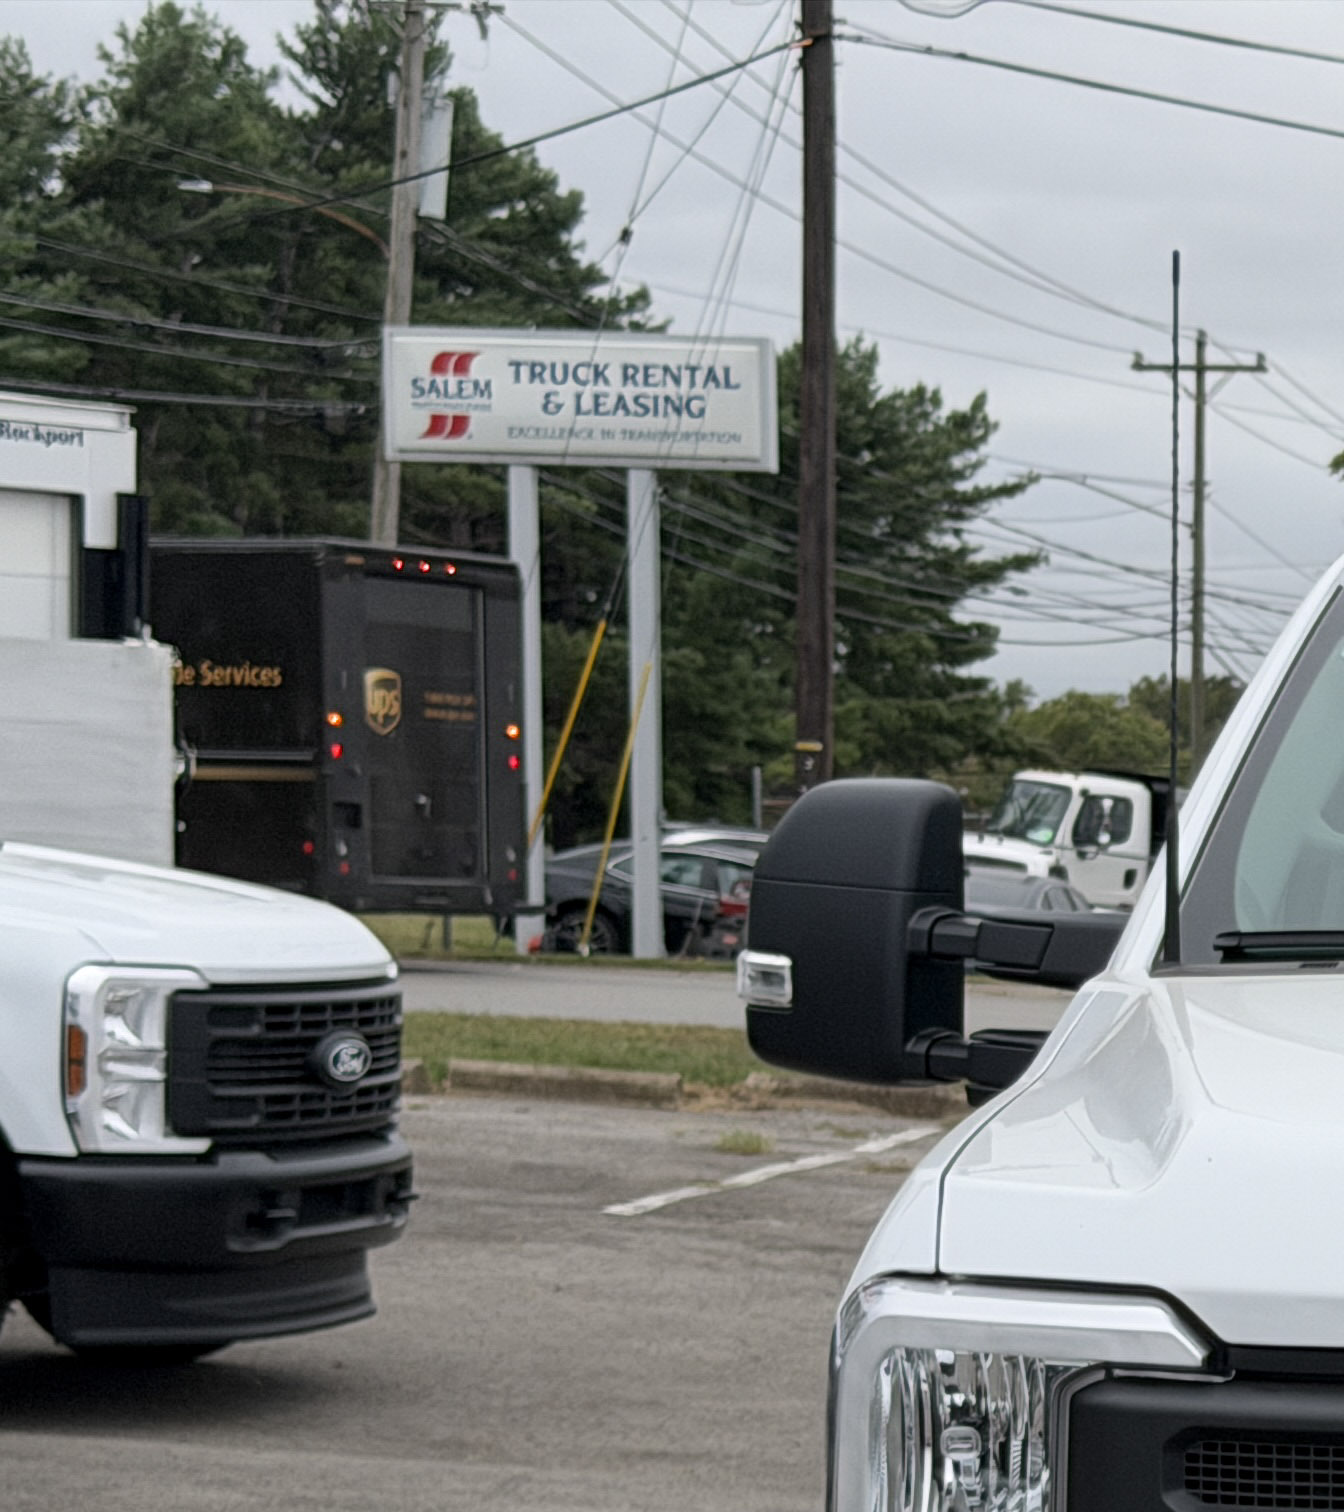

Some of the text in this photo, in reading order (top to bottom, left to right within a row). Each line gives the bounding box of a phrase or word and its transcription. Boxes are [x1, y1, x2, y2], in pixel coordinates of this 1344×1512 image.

[411, 377, 492, 400] SALEM
[508, 361, 741, 390] TRUCK RENTAL
[542, 392, 706, 418] & LEASING
[200, 659, 282, 686] Services
